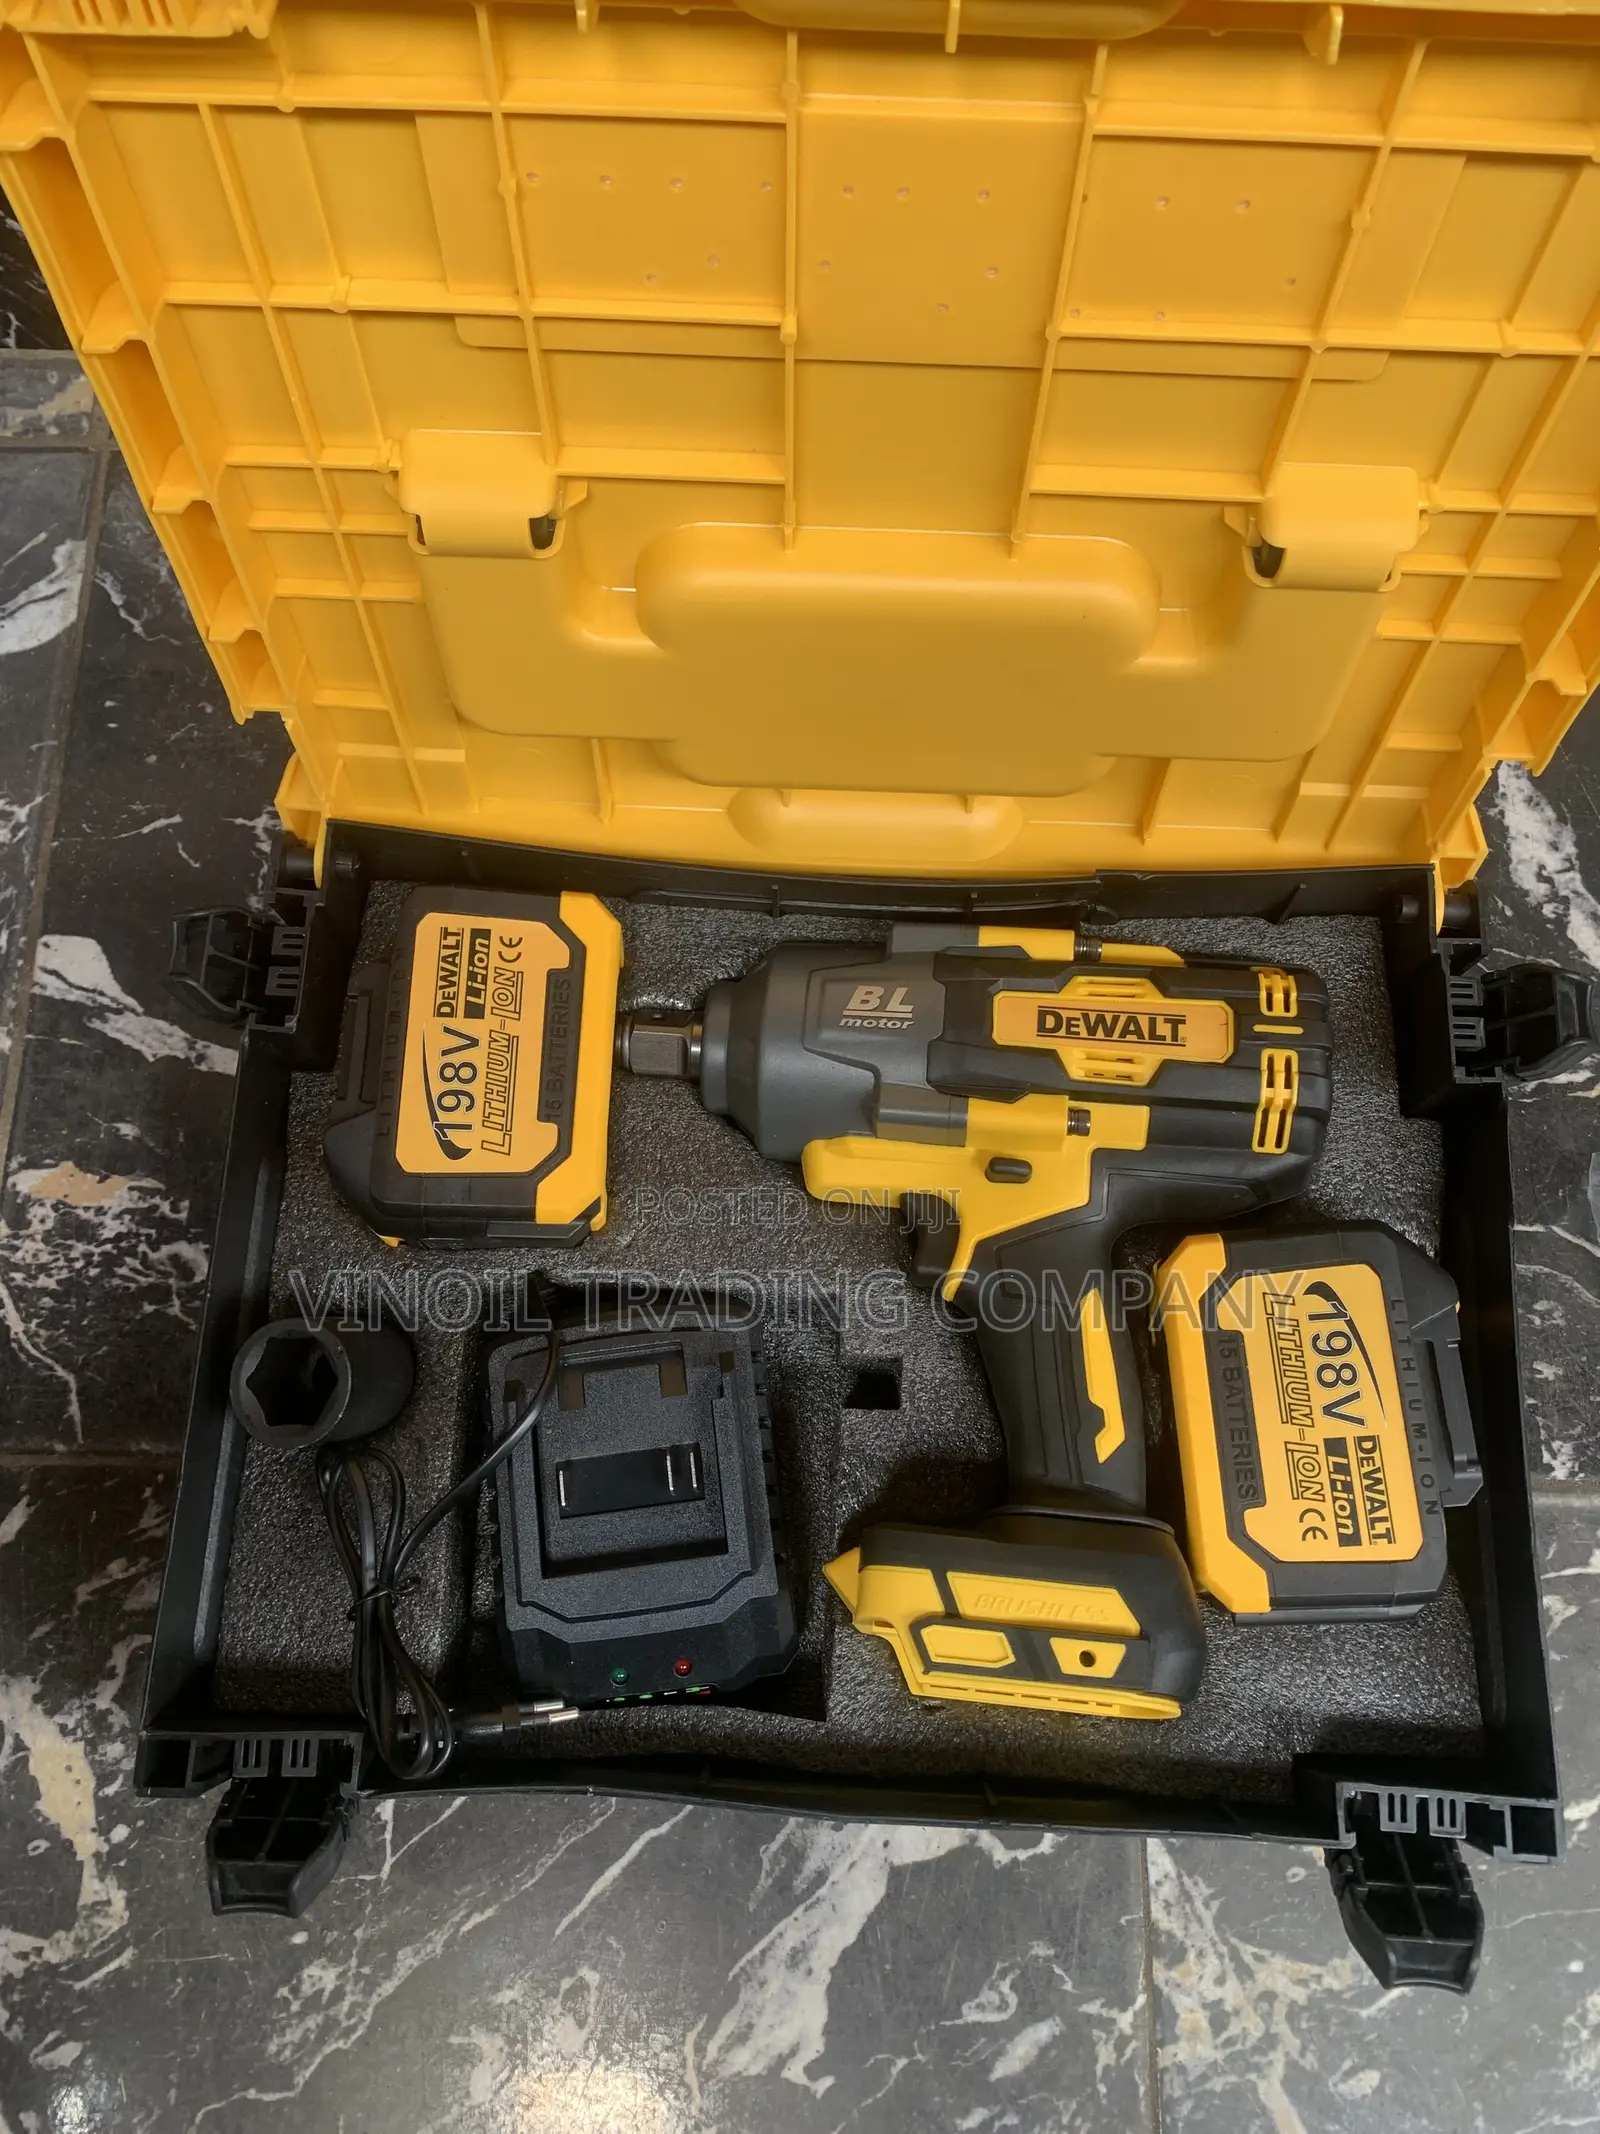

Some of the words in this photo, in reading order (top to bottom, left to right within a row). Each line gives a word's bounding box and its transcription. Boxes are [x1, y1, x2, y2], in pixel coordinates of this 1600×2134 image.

[466, 937, 491, 1007] Li-ion
[838, 1015, 915, 1031] motor
[845, 985, 915, 1012] BL
[432, 1023, 481, 1141] 198V
[481, 968, 524, 1156] LITHIUM-ION
[1261, 1291, 1326, 1503] LITHIUM-ION
[1306, 1300, 1369, 1429] 198V
[1390, 1297, 1440, 1517] LITHIUM-ION
[1220, 1365, 1258, 1500] BATTERIES
[1328, 1456, 1355, 1537] Li-ion
